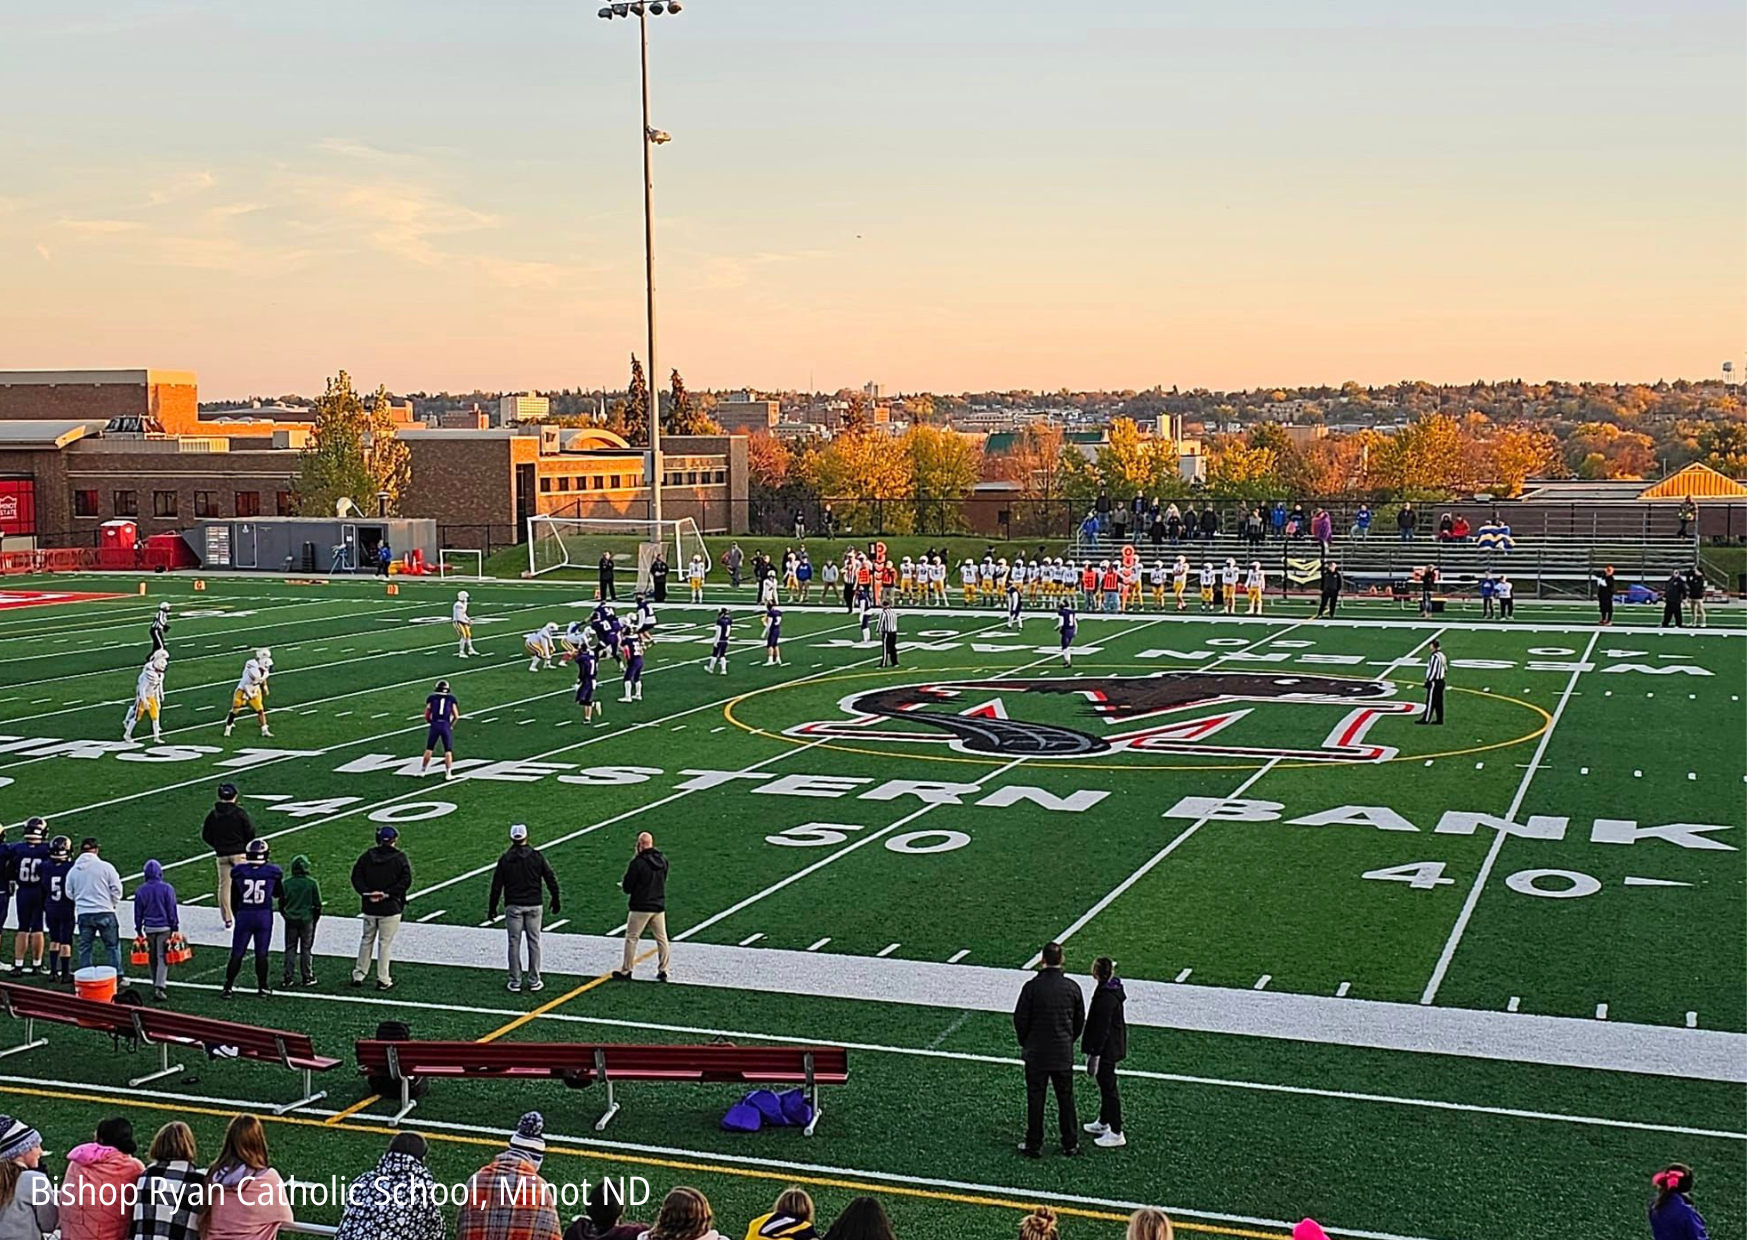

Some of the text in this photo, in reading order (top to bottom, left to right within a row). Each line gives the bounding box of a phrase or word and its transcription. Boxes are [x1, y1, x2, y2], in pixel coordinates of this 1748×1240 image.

[1134, 649, 1715, 676] WESTERN
[439, 697, 446, 715] 1
[0, 735, 1740, 851] IRST WESTERN BANK
[266, 797, 458, 822] 40
[765, 823, 972, 853] 50
[51, 876, 62, 902] 5
[243, 879, 266, 904] 26
[1362, 862, 1602, 897] 40
